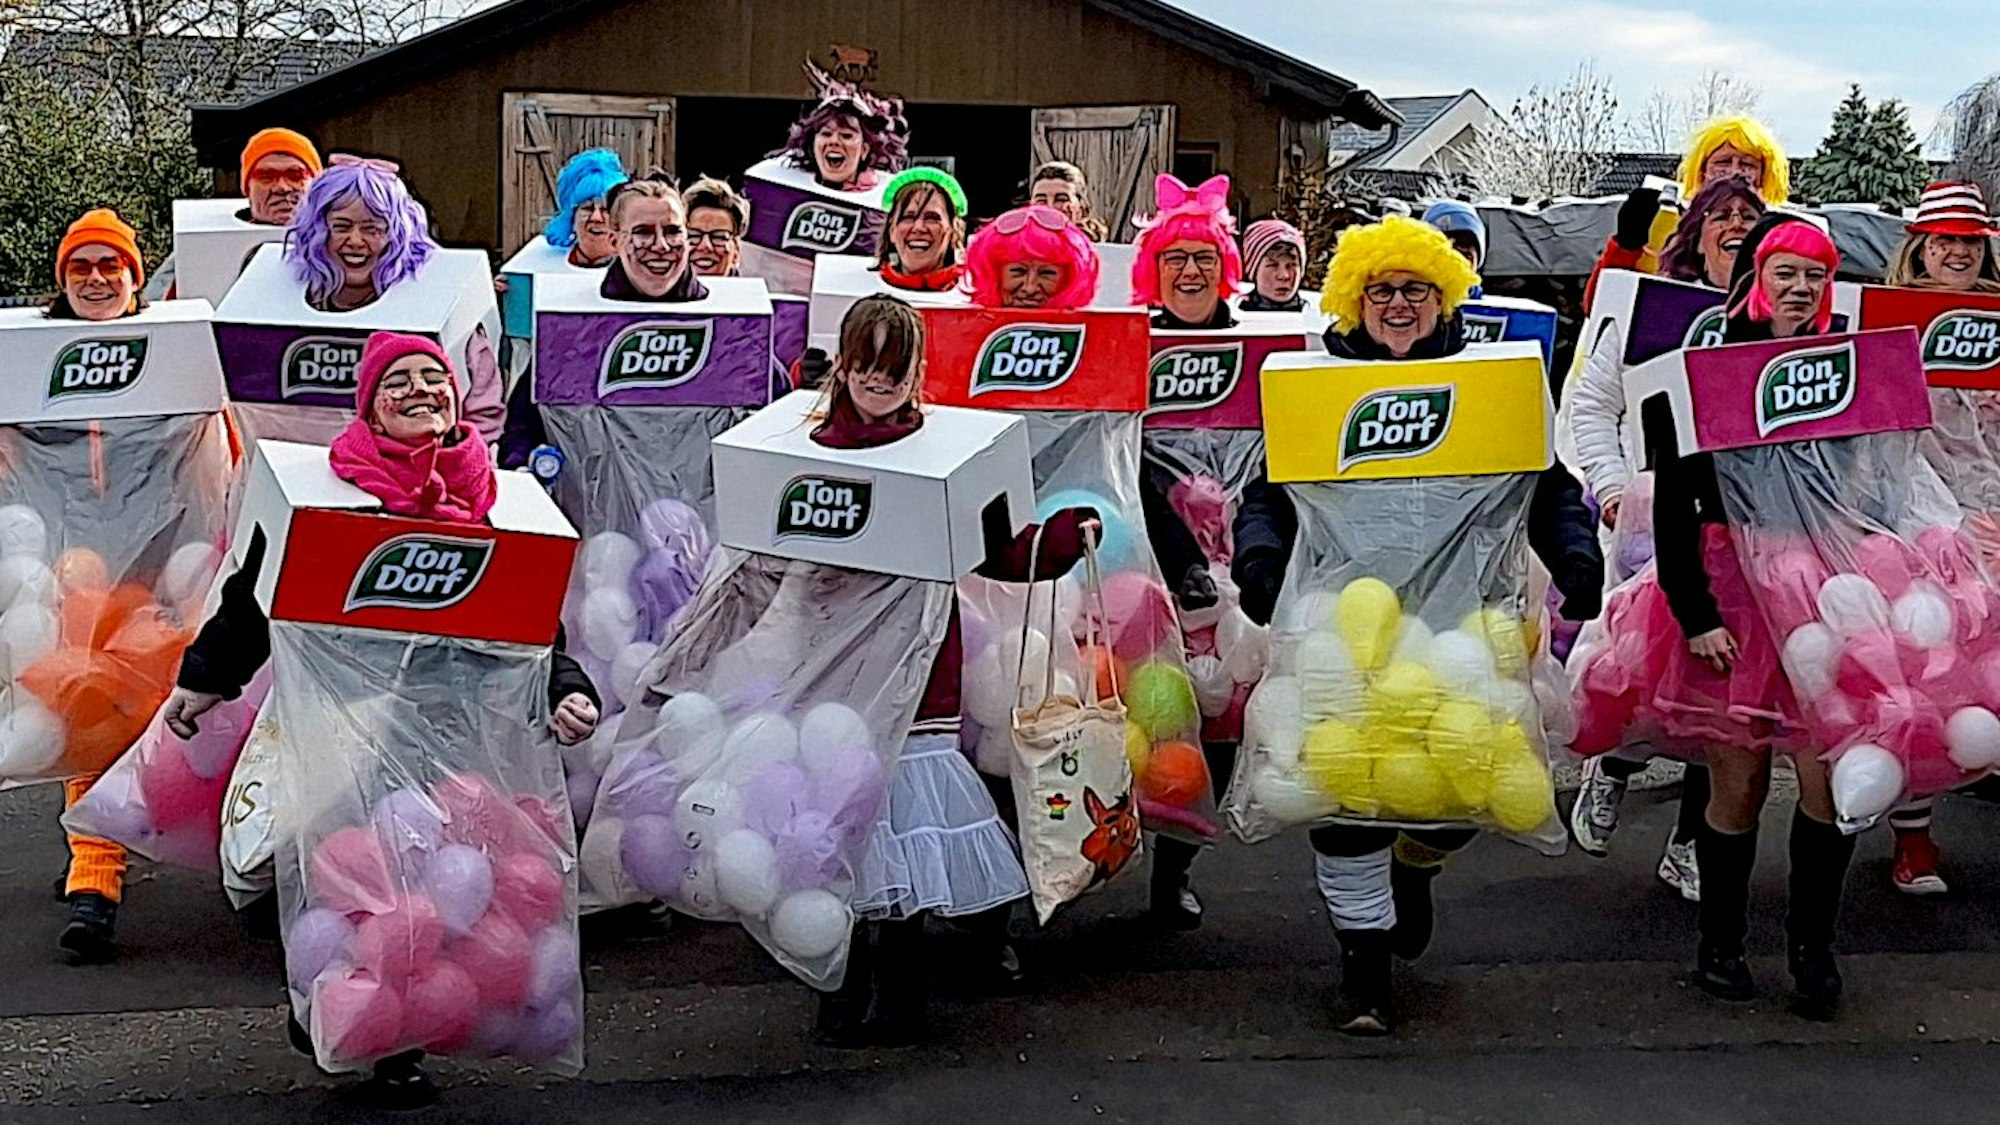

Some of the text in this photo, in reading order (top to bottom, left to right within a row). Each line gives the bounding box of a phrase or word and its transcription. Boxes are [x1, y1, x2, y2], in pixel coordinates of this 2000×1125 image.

[809, 208, 844, 228] Ton
[799, 222, 847, 243] Dorf
[1461, 324, 1487, 339] on
[1952, 316, 1997, 339] Ton
[78, 342, 127, 365] Ton
[311, 344, 358, 364] Ton
[635, 330, 685, 353] Ton
[1008, 330, 1060, 355] Ton
[1935, 335, 2000, 358] Dorf
[62, 359, 136, 387] Dorf
[620, 348, 693, 374] Dorf
[991, 352, 1068, 377] Dorf
[1169, 352, 1219, 374] Ton
[1784, 359, 1833, 384] Ton
[1156, 370, 1225, 398] Dorf
[1773, 374, 1841, 409] Dorf
[1375, 396, 1428, 422] Ton
[1359, 414, 1435, 447] Dorf
[803, 480, 853, 505] Ton
[790, 500, 859, 529] Dorf
[400, 542, 464, 571] Ton
[374, 564, 467, 594] Dorf
